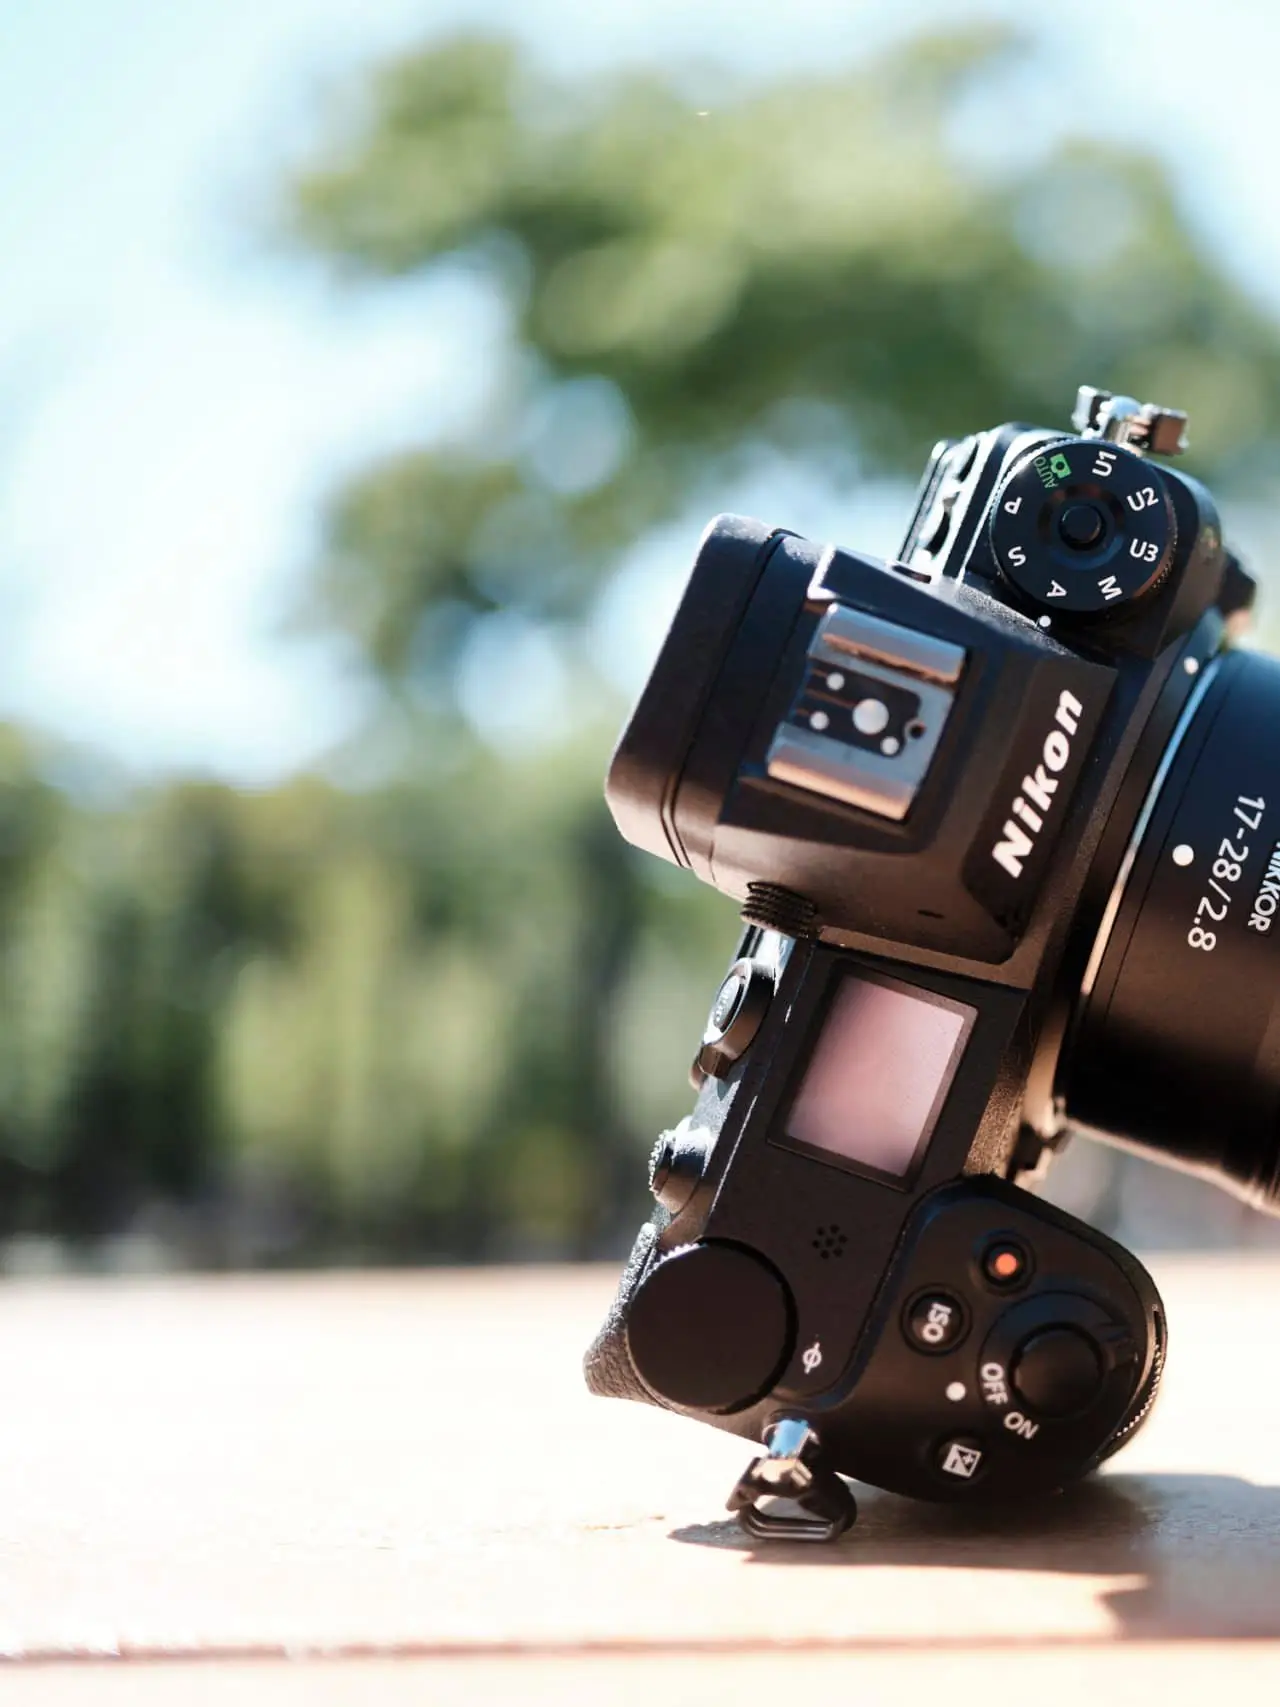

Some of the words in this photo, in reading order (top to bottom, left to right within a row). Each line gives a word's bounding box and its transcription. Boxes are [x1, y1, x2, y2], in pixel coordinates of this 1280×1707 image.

[1033, 457, 1057, 488] AUTO
[1092, 451, 1117, 477] U1
[1004, 497, 1022, 515] P
[1127, 487, 1158, 511] U2
[1008, 546, 1026, 567] S
[1129, 538, 1159, 562] U3
[1047, 580, 1066, 597] A
[1097, 575, 1123, 600] M
[992, 689, 1083, 879] Nikon
[1187, 796, 1266, 951] 17-28/2.8
[922, 1303, 951, 1343] ISO
[981, 1361, 1008, 1405] OFF
[1004, 1412, 1039, 1439] ON
